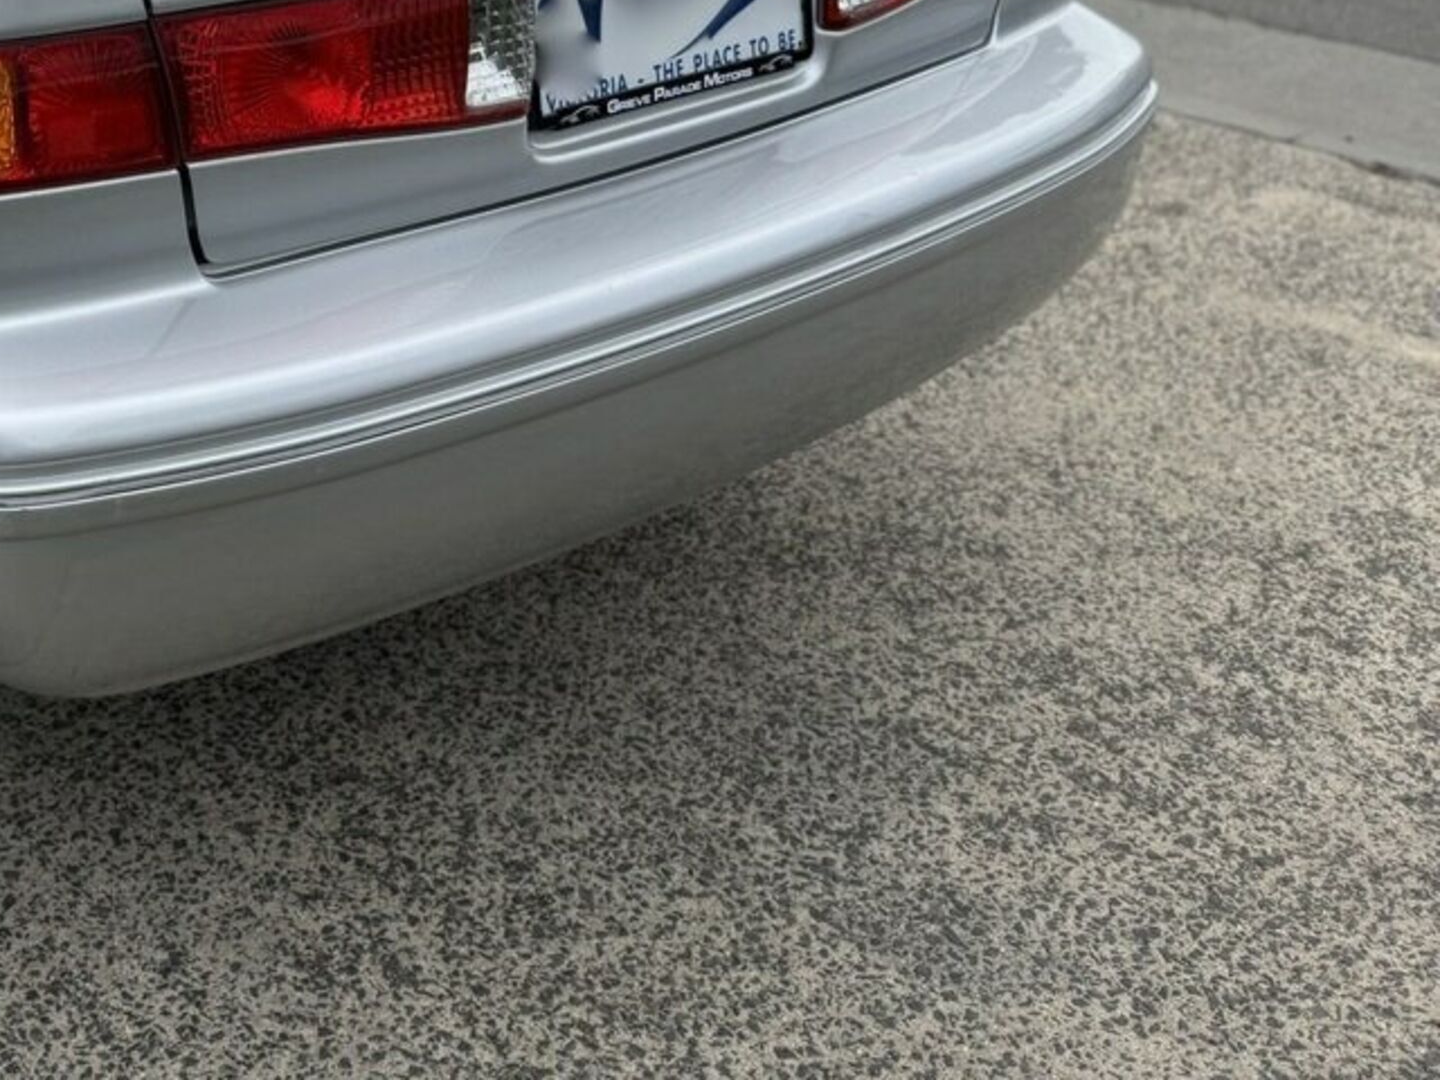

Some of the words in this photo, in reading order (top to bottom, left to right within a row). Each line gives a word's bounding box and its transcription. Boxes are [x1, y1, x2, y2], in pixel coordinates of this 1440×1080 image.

[653, 56, 684, 85] THE
[693, 41, 742, 73] PLACE
[749, 35, 770, 58] TO
[703, 65, 754, 90] MOTORS
